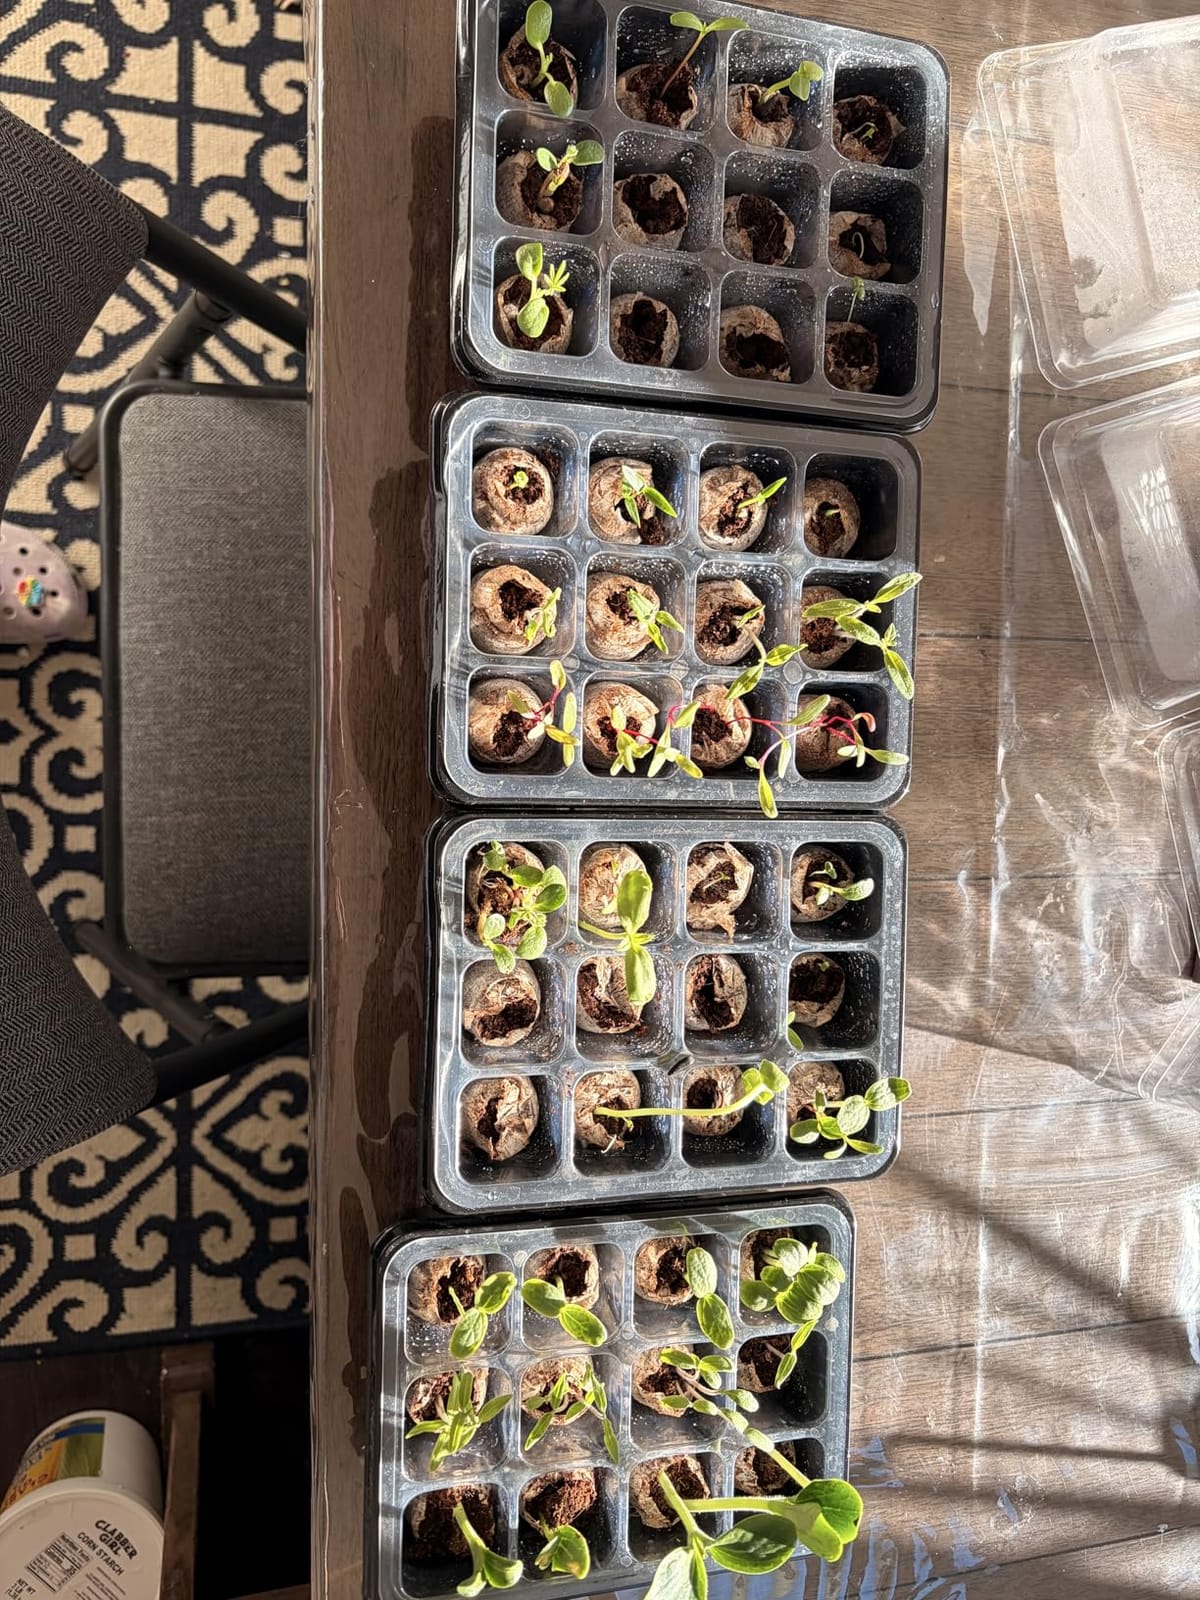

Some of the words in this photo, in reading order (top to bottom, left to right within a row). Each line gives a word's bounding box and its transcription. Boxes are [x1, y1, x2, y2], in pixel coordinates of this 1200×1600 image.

[77, 1532, 99, 1551] CORN
[96, 1549, 124, 1576] STARCH
[95, 1519, 138, 1560] CLABBER
[99, 1533, 121, 1556] GIRL
